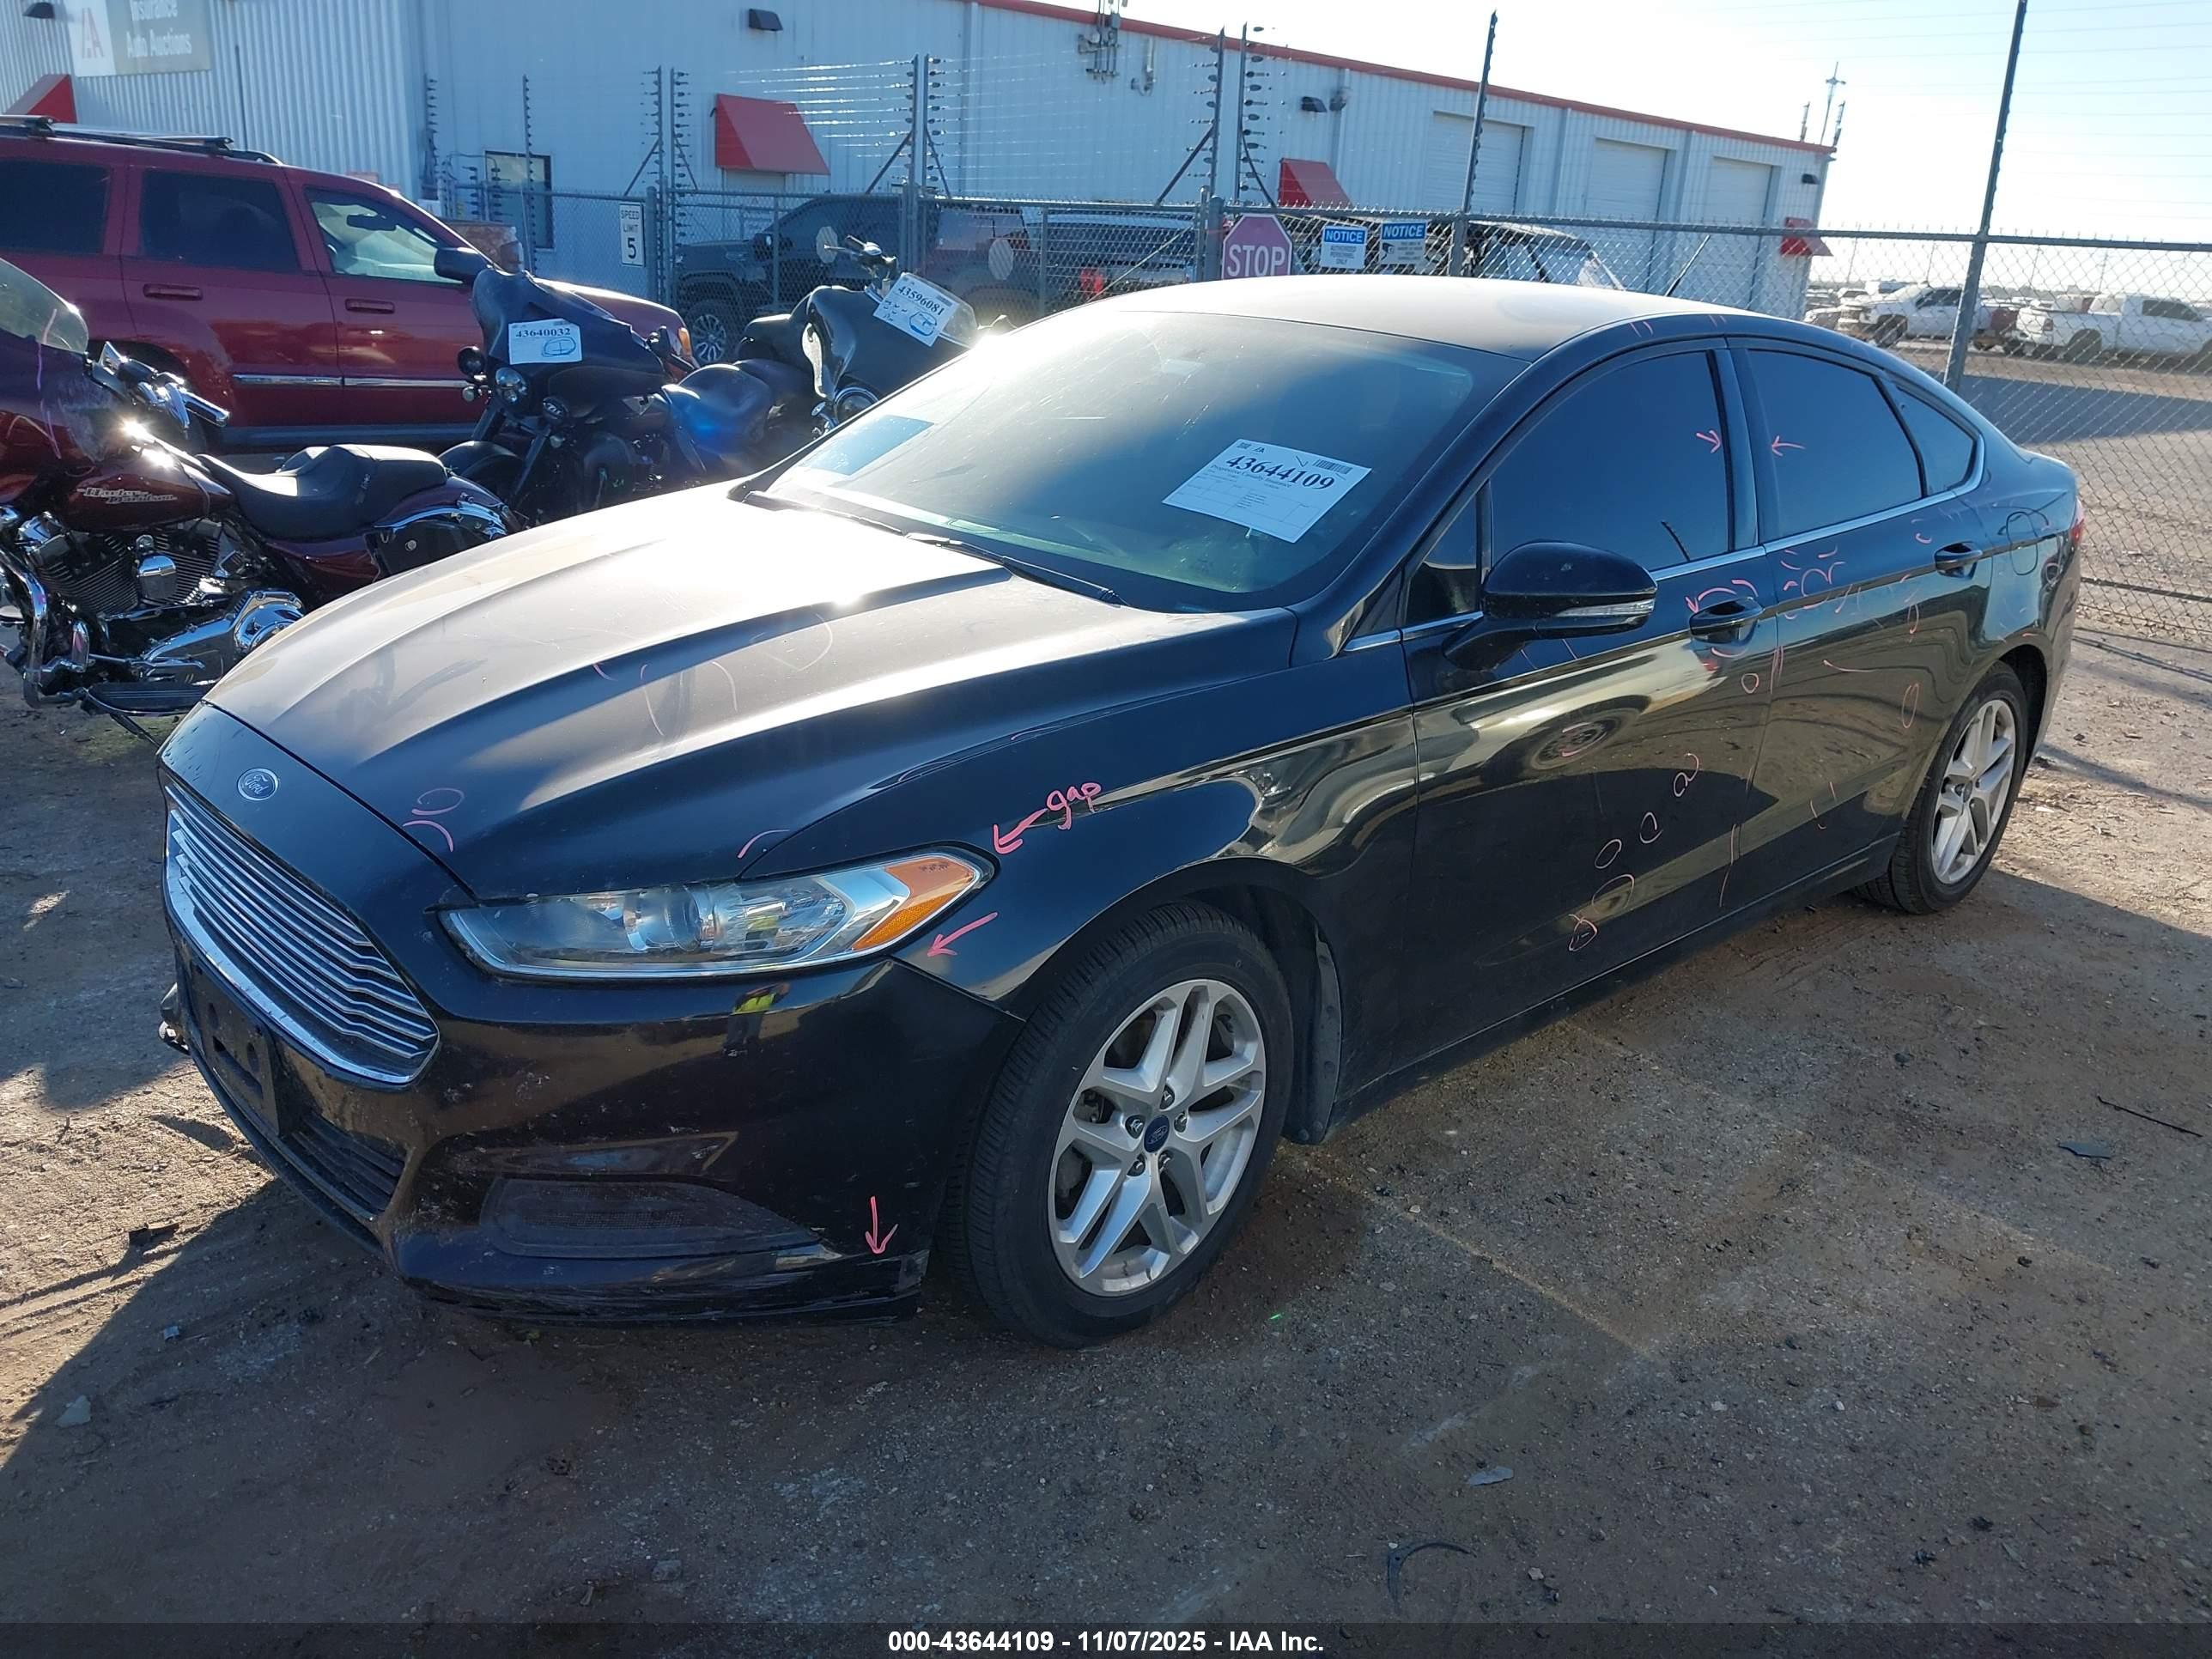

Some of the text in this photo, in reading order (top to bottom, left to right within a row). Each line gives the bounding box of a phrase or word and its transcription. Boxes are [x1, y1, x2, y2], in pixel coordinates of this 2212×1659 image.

[621, 210, 640, 220] SPEED
[623, 223, 639, 233] LIMIT
[1325, 228, 1364, 243] NOTICE
[1382, 223, 1424, 239] NOTICE
[628, 237, 637, 259] 5
[1227, 244, 1286, 277] STOP
[897, 285, 945, 316] 43596081
[516, 327, 571, 337] 43640032
[1225, 455, 1336, 489] 43644109
[1046, 781, 1102, 830] gap
